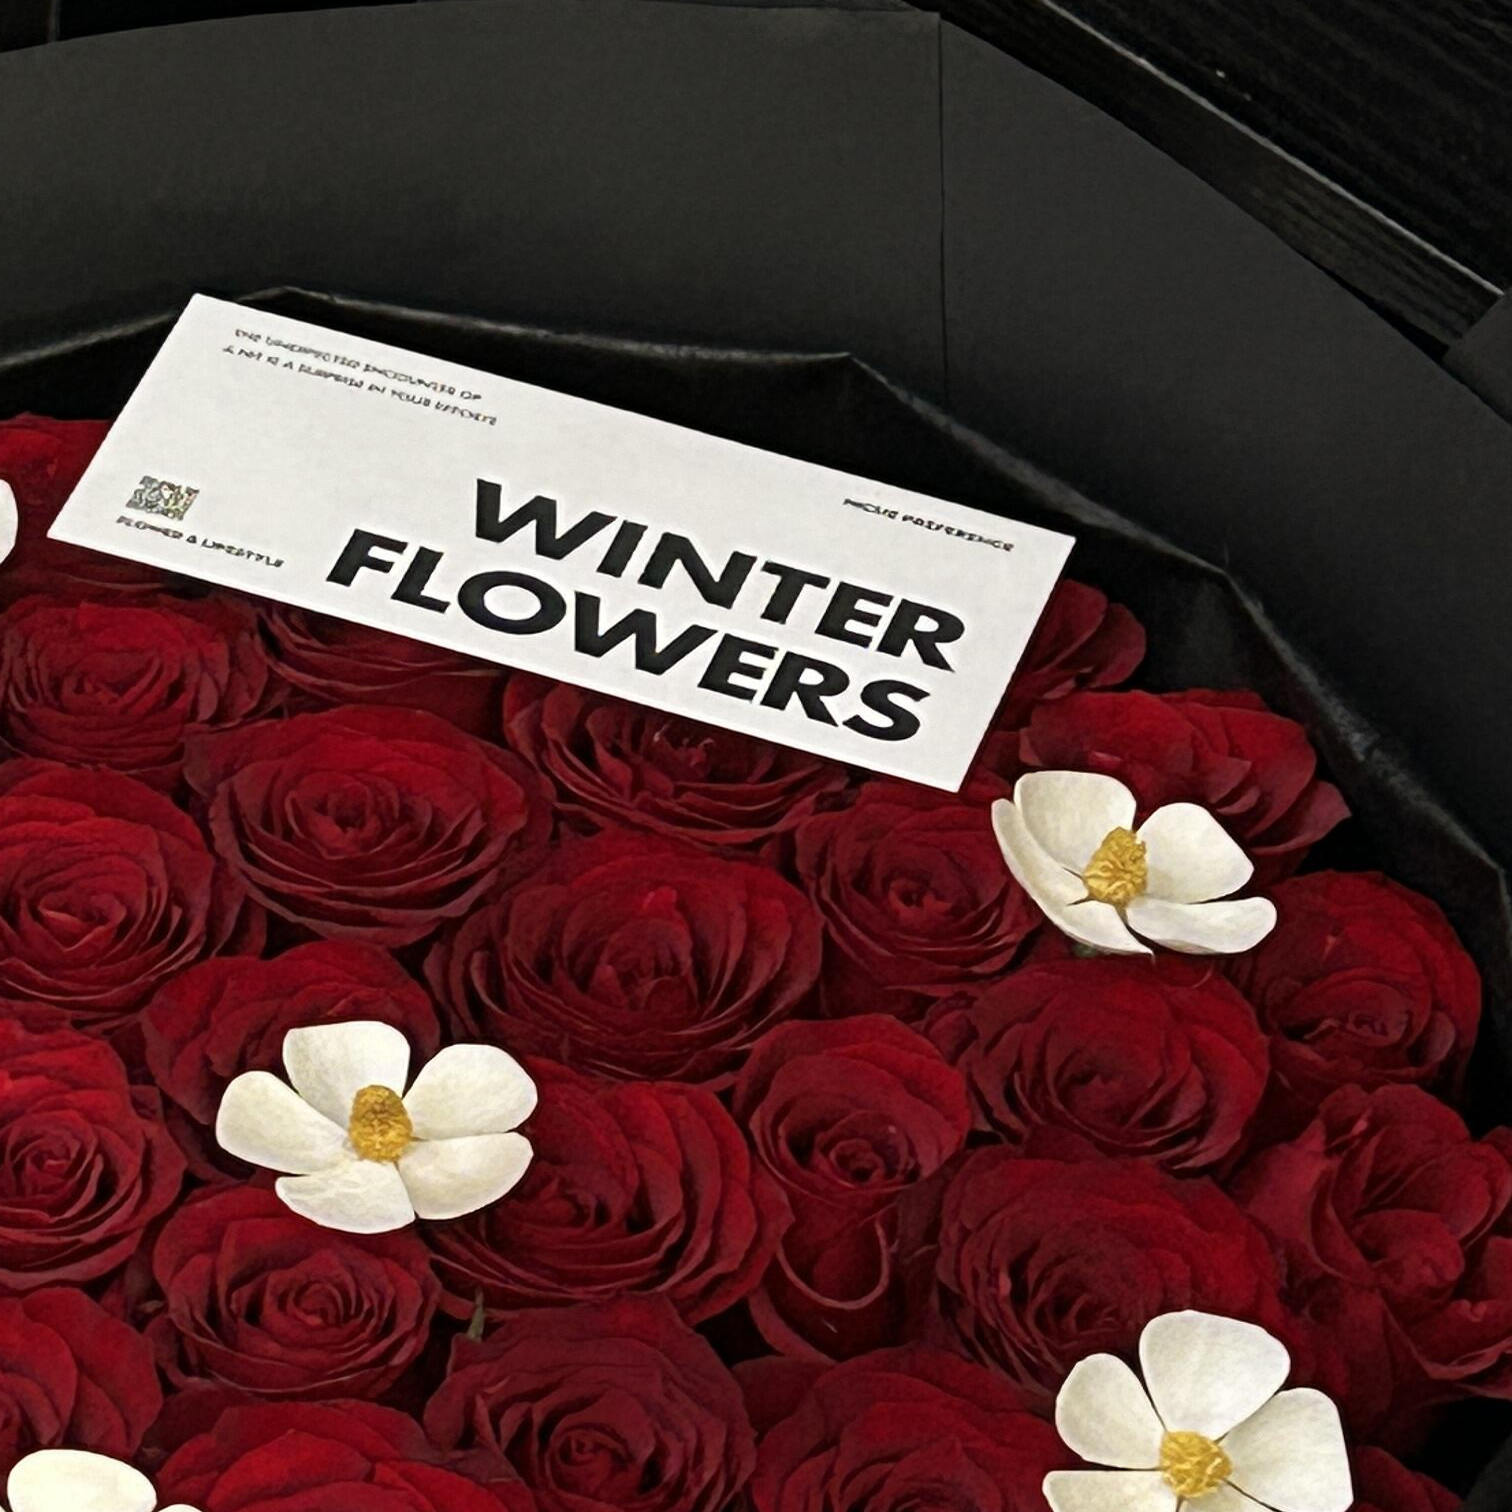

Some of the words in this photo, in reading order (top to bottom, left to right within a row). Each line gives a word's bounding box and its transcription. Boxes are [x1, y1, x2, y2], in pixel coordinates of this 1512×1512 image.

[115, 514, 184, 540] FLOWER
[200, 537, 285, 568] LIFESTYLE
[325, 527, 931, 742] FLOWERS
[474, 477, 966, 674] WINTER
